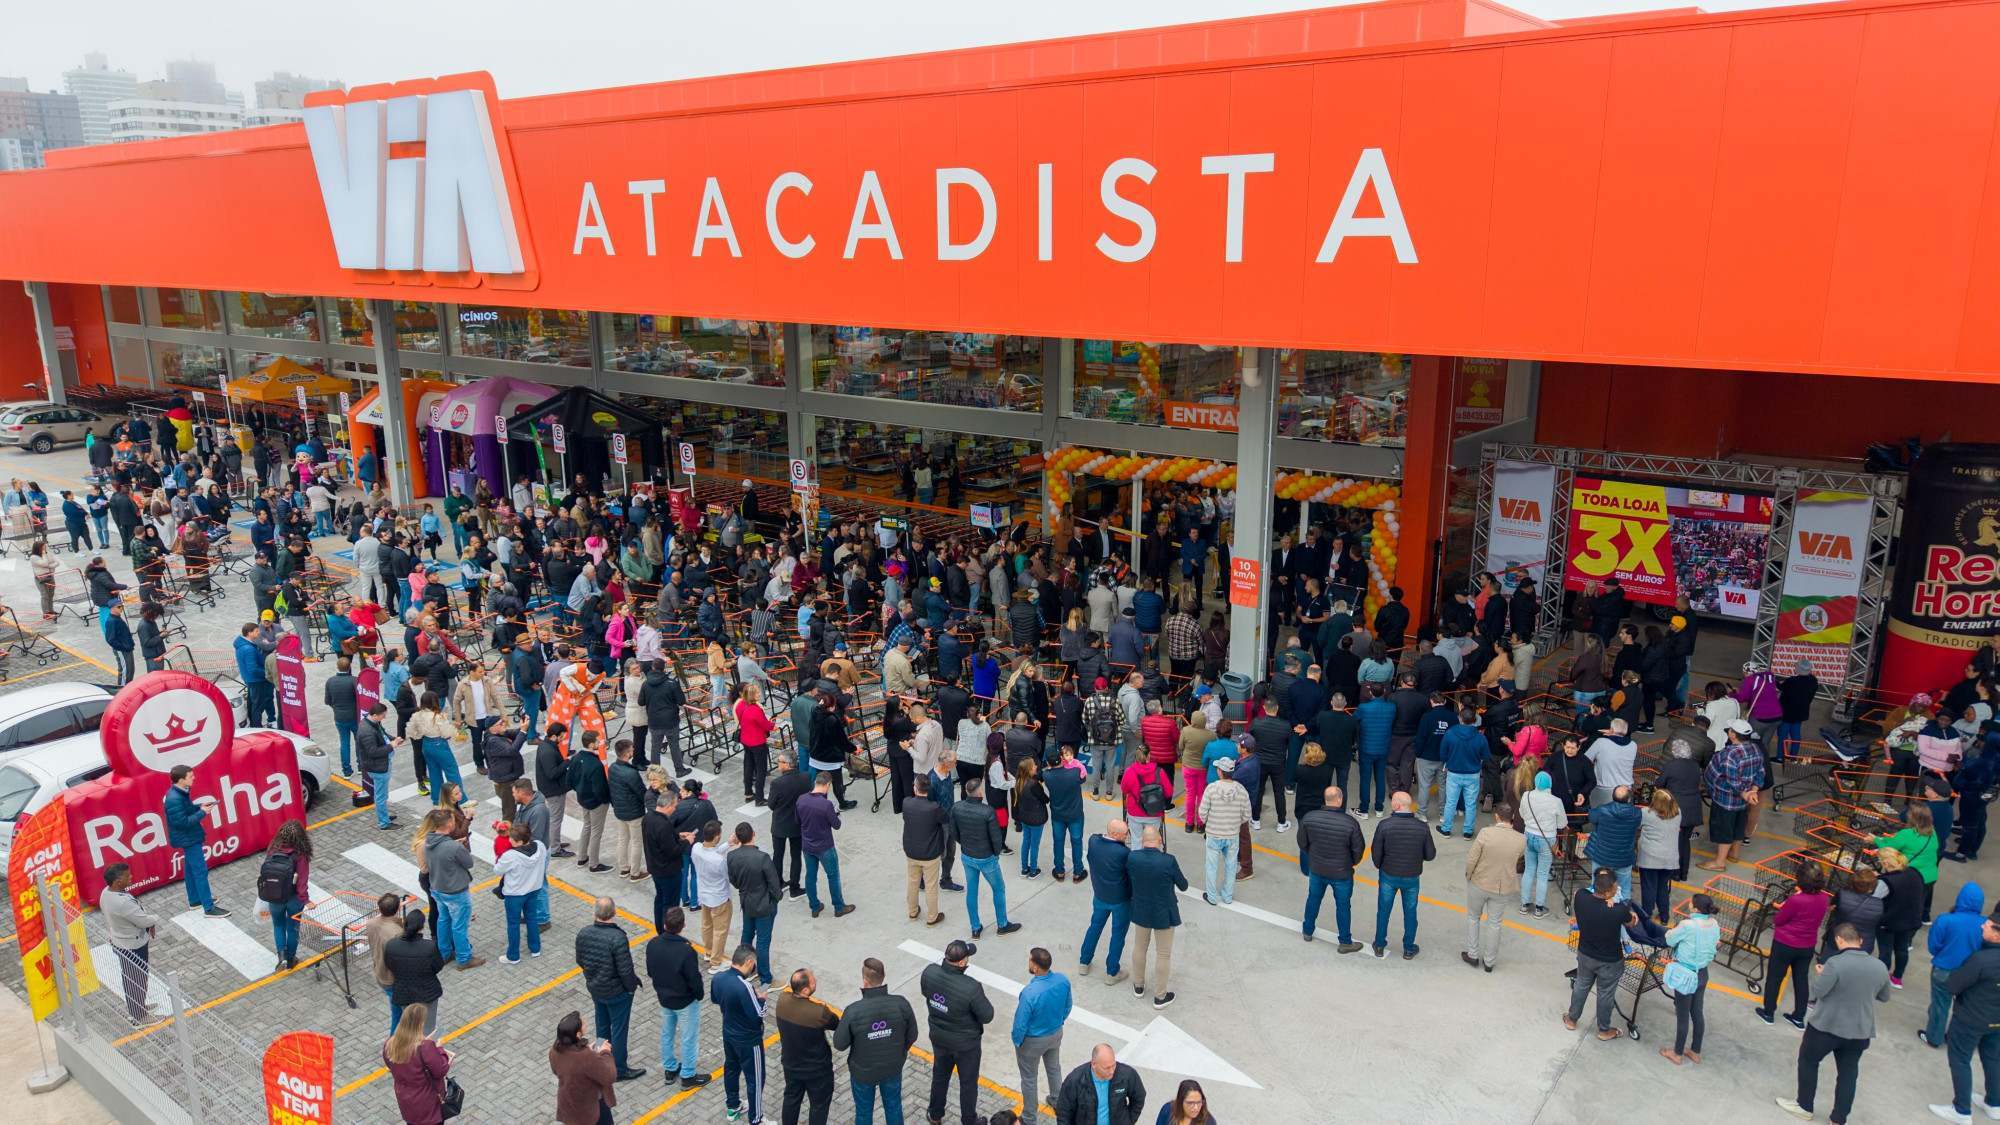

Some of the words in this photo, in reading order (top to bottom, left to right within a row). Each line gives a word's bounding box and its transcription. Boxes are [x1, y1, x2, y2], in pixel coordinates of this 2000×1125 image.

[573, 148, 1419, 264] ATACADISTA
[1172, 406, 1239, 427] ENTRA
[1582, 493, 1619, 509] TODA
[1624, 498, 1660, 513] LOJA
[1572, 514, 1671, 577] 3X
[1233, 569, 1256, 580] km/h
[1239, 561, 1251, 571] 10
[1615, 571, 1633, 581] SEM
[1943, 621, 1993, 630] ENERGY
[84, 772, 293, 869] Ranha
[24, 842, 62, 872] AQUI
[277, 1071, 324, 1101] AQUI
[281, 1090, 320, 1118] TEM
